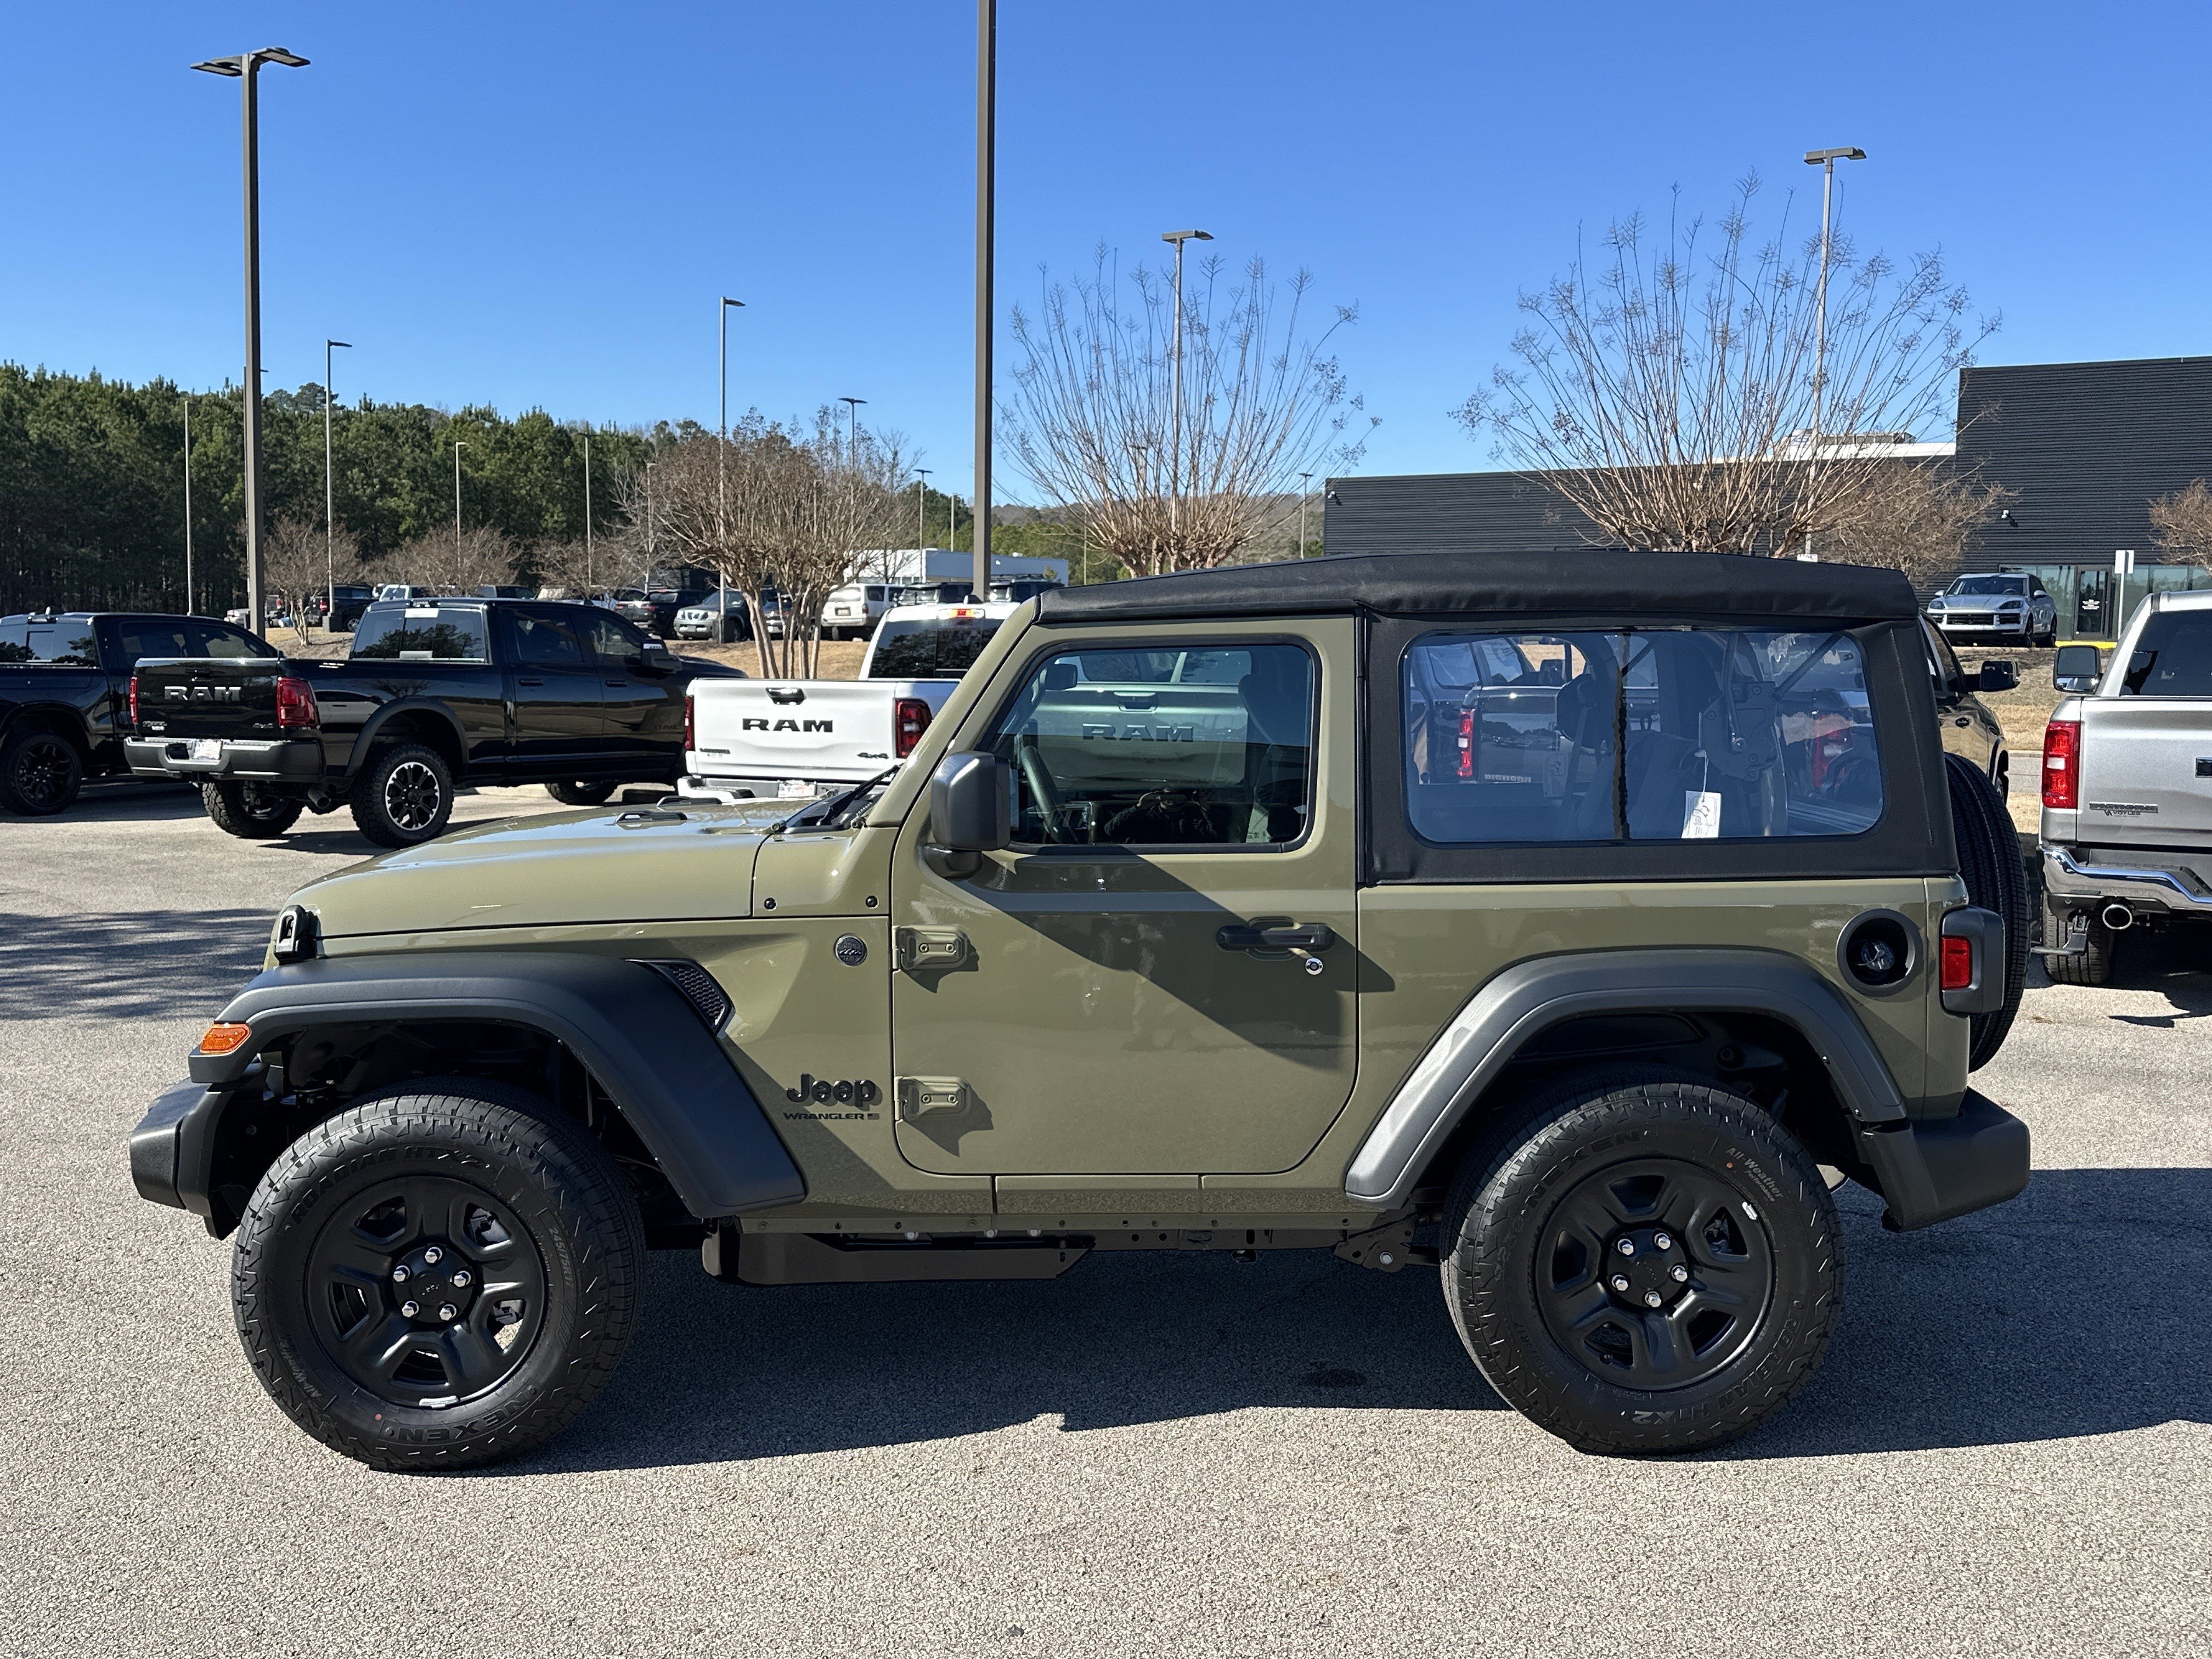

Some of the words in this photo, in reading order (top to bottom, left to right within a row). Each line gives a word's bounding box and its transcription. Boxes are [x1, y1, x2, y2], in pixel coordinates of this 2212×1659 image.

[165, 686, 241, 702] RAM
[742, 718, 833, 732] RAM
[1082, 723, 1194, 742] RAM
[785, 1073, 877, 1108] Jeep
[782, 1112, 865, 1120] WRANGLER
[290, 1147, 397, 1226] ROADIAN
[1524, 1128, 1640, 1209] NEXEN
[1725, 1147, 1784, 1198] All-Weather
[549, 1227, 575, 1289] 245/75R17
[398, 1391, 531, 1442] NEXEN
